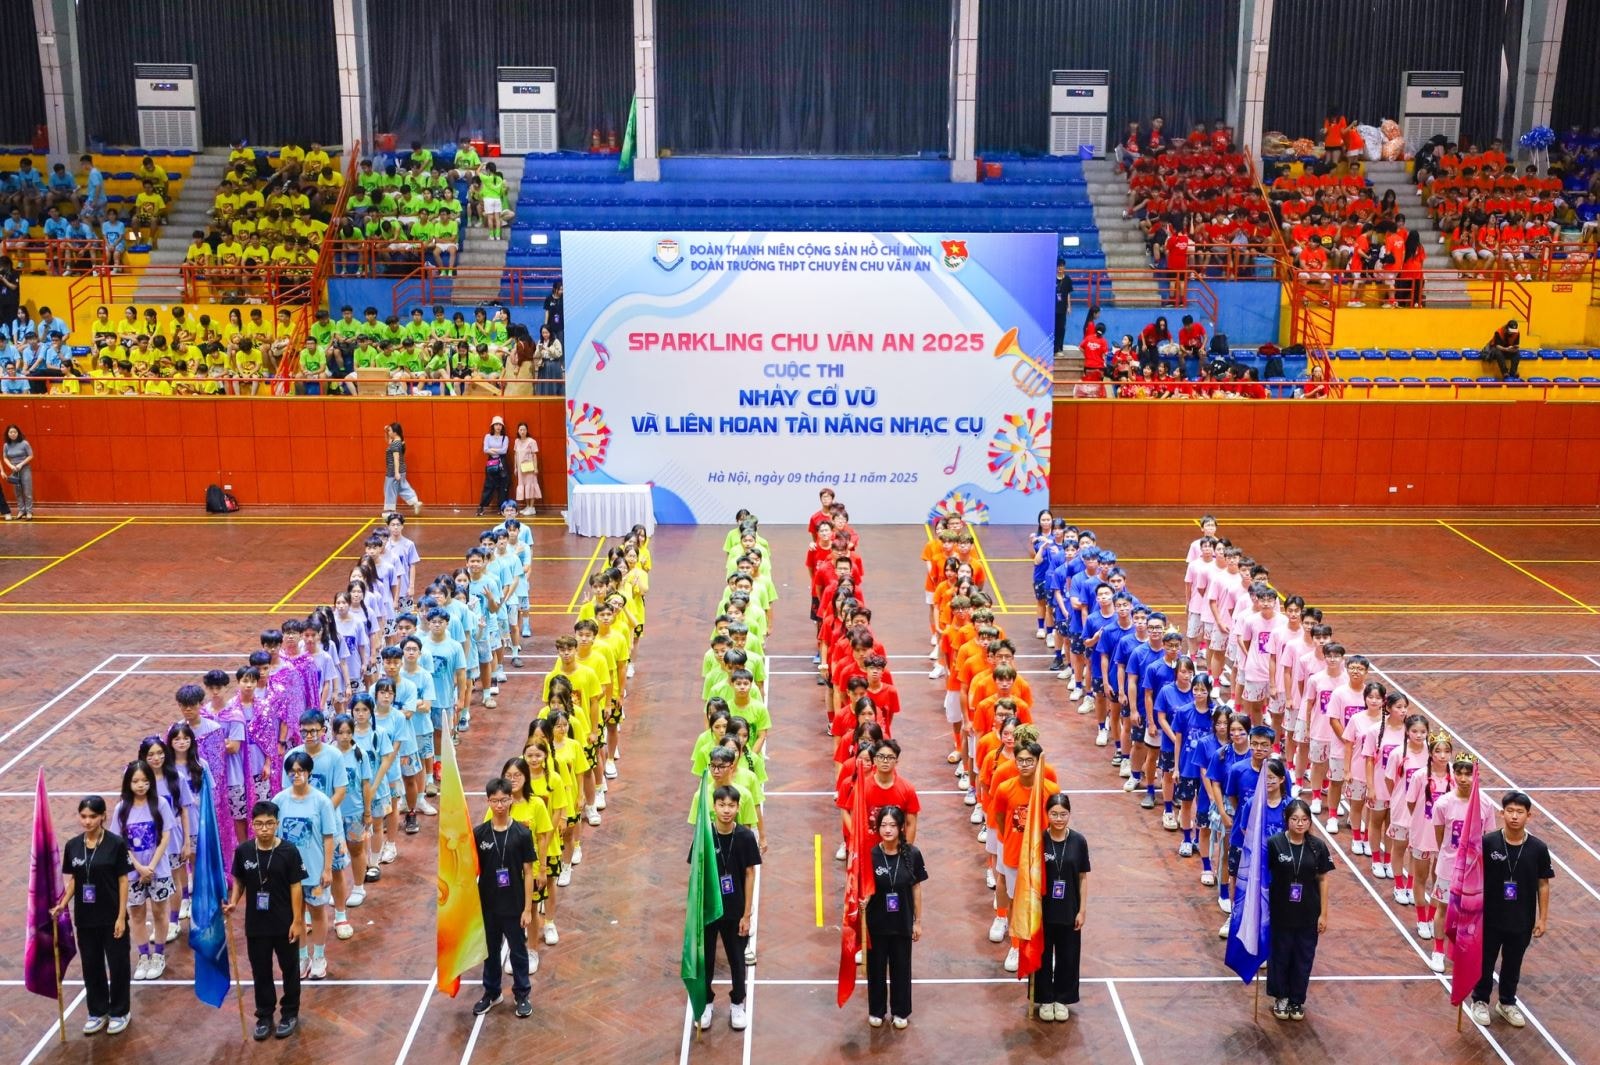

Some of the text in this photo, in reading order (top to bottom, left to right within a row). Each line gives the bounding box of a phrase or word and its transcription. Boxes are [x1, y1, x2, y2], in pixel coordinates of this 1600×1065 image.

[690, 240, 932, 258] ĐOÀN THANH NIÊN CỘNG SẢN HỒ CHÍ MINH
[690, 257, 724, 271] ĐOÀN
[727, 257, 775, 272] TRƯỜNG
[778, 260, 807, 272] THPT
[809, 258, 857, 271] CHUYÊN
[860, 260, 885, 271] CHU
[887, 258, 911, 271] VĂN
[914, 260, 931, 271] AN
[628, 330, 985, 351] SPARKLING CHU VĂN AN 2025
[763, 361, 845, 381] CUỘC THI
[739, 384, 800, 406] NHẢY
[845, 386, 876, 407] VŨ
[631, 411, 984, 438] VÀ LIÊN HOAN TÀI NĂNG NHẠC CỤ
[708, 471, 918, 486] Hà Nội, ngày 09 tháng 11 năm 2025
